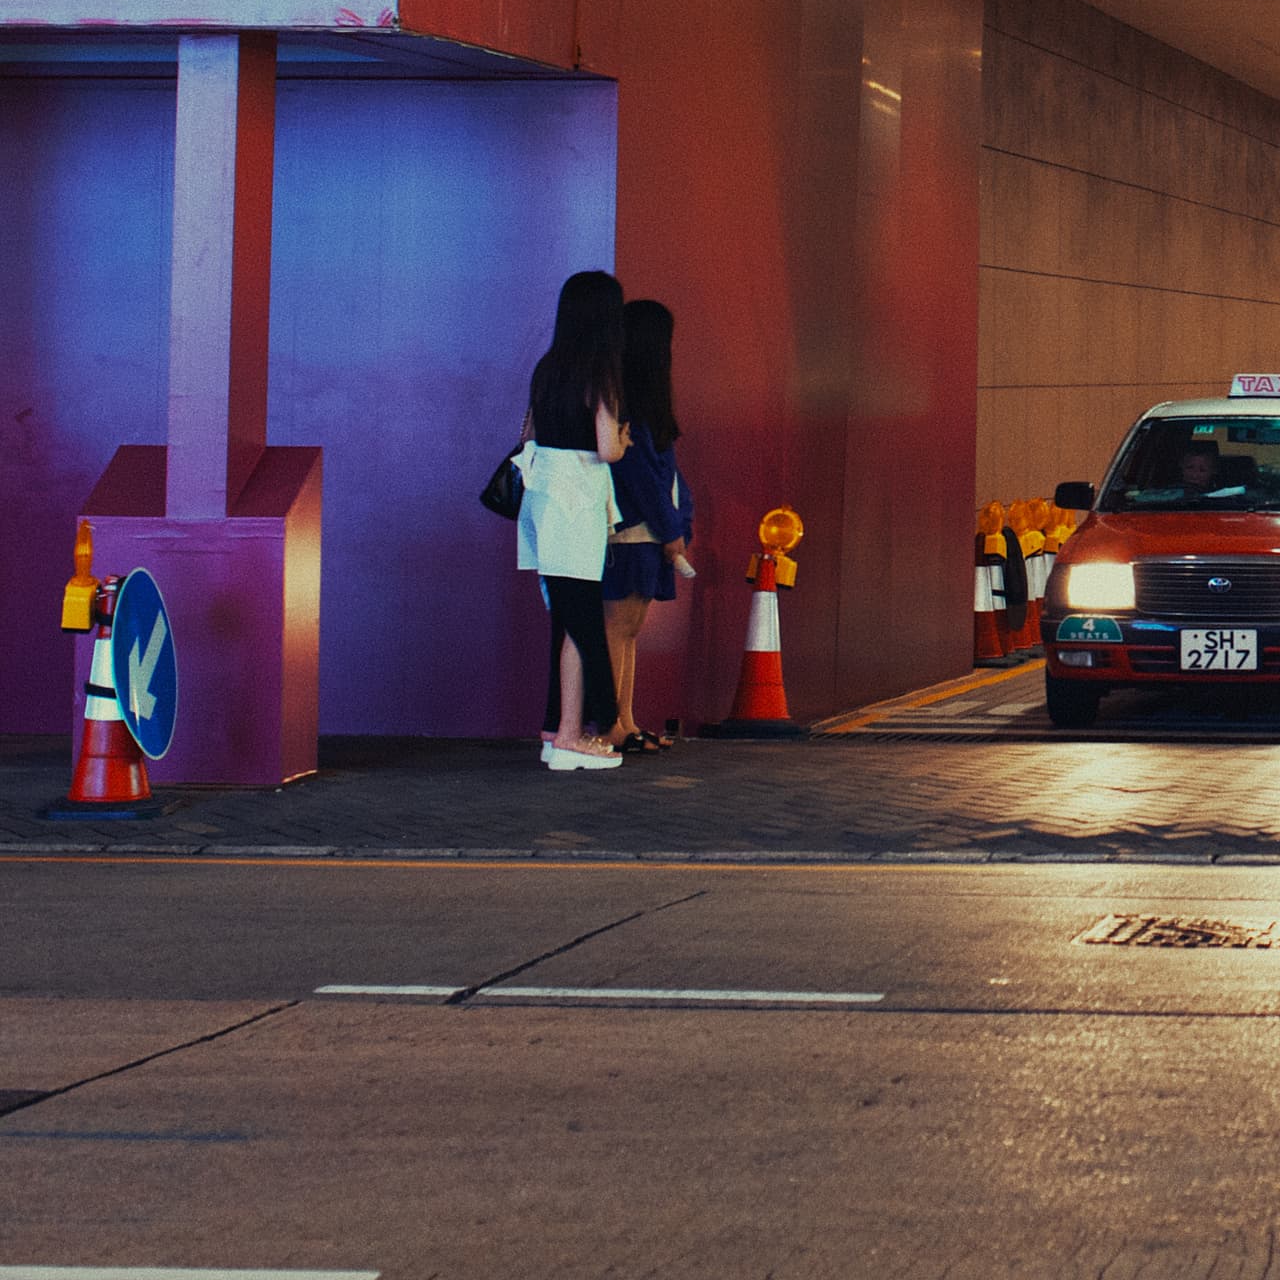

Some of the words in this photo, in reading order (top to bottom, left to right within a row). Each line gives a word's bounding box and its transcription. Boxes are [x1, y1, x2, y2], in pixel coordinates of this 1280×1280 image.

[1082, 618, 1096, 632] 4
[1070, 632, 1109, 640] SEATS
[1205, 631, 1235, 650] SH
[1187, 649, 1250, 669] 2717
